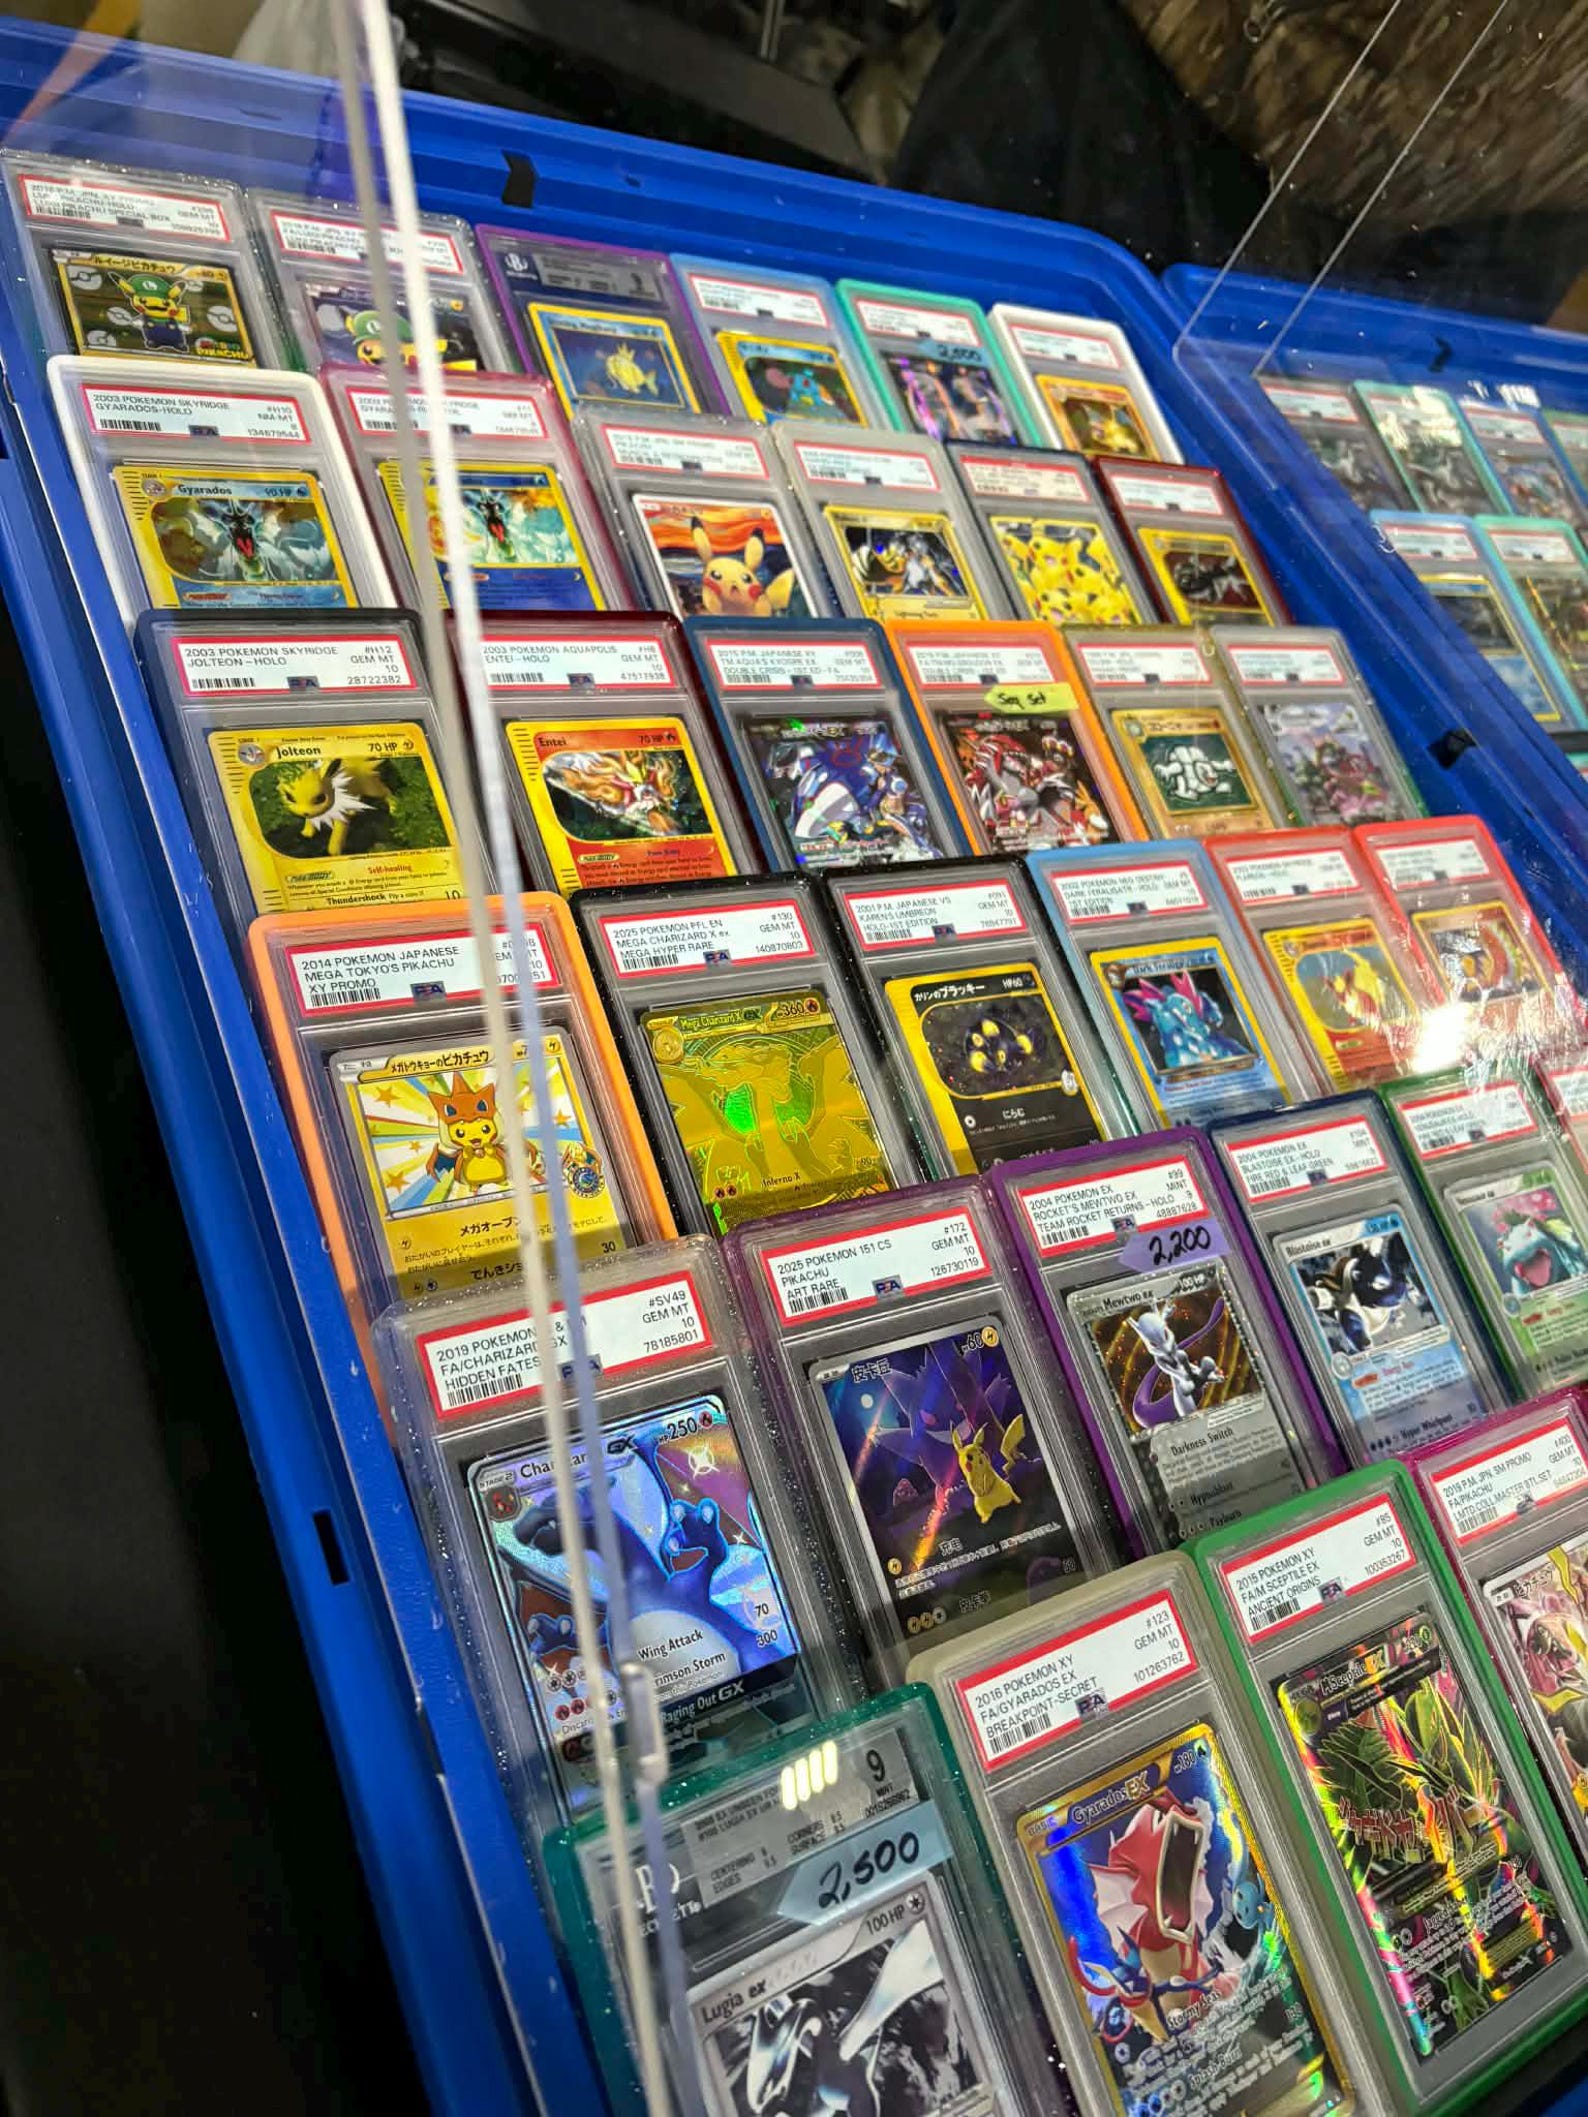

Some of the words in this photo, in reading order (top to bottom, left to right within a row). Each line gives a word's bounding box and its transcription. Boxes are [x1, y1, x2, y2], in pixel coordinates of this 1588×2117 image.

[93, 394, 119, 402] 2003
[122, 396, 175, 405] POKEMON
[178, 399, 228, 408] SKYRIDGE
[96, 403, 192, 414] GYARADOS-HOLO
[178, 483, 232, 496] Gyarados
[185, 648, 216, 656] 2003
[218, 647, 278, 656] POKEMON
[281, 646, 336, 654] SKYRIDGE
[350, 655, 375, 663] GEM
[190, 658, 243, 667] JOLTEON
[253, 657, 287, 665] HOLO
[385, 664, 399, 672] 10
[368, 742, 382, 751] 70
[385, 742, 398, 751] HP
[538, 737, 567, 747] Entei
[638, 735, 651, 744] 70
[653, 735, 663, 743] HP
[276, 746, 321, 759] Jolteon
[326, 893, 386, 905] Thundershock
[613, 928, 638, 938] 2025
[640, 923, 689, 935] POKEMON
[709, 920, 723, 928] EN
[759, 923, 780, 933] GEM
[781, 921, 795, 930] MT
[790, 931, 800, 939] 10
[616, 938, 647, 948] MEGA
[649, 931, 707, 944] CHARIZARD
[302, 959, 332, 970] 2014
[334, 952, 396, 967] POKEMON
[400, 946, 459, 960] JAPANESE
[620, 948, 651, 958] MEGA
[653, 944, 686, 955] HYPER
[688, 941, 714, 951] RARE
[304, 970, 344, 982] MEGA
[346, 963, 400, 977] TOKYO'S
[401, 958, 454, 971] PIKACHU
[309, 983, 326, 994] XY
[330, 978, 376, 991] PROMO
[783, 1001, 804, 1017] 360
[1258, 1145, 1296, 1158] POKEMON
[1166, 1179, 1187, 1191] MINT
[1029, 1197, 1053, 1210] 2004
[1054, 1188, 1100, 1204] POKEMON
[1100, 1185, 1113, 1194] EX
[1033, 1203, 1080, 1221] ROCKET'S
[1080, 1194, 1124, 1211] MEWTWO
[1124, 1191, 1136, 1201] EX
[1037, 1219, 1065, 1232] TEAM
[1066, 1210, 1101, 1226] ROCKET
[1103, 1201, 1144, 1218] RETURNS
[1150, 1194, 1175, 1207] HOLO
[944, 1222, 966, 1234] #172
[601, 1241, 616, 1253] 30
[931, 1237, 953, 1250] GEM
[954, 1233, 969, 1244] MT
[963, 1246, 975, 1256] 10
[1149, 1225, 1211, 1266] 2,200
[777, 1260, 804, 1274] 2025
[805, 1248, 857, 1267] POKEMON
[859, 1243, 876, 1254] 151
[877, 1239, 892, 1250] CS
[930, 1256, 979, 1276] 126730119
[781, 1267, 829, 1287] PIKACHU
[649, 1290, 686, 1307] #SV49
[787, 1286, 808, 1300] ART
[810, 1278, 840, 1294] RARE
[1103, 1293, 1140, 1307] Mewtwo
[642, 1308, 669, 1324] GEM
[670, 1303, 688, 1316] MT
[682, 1316, 695, 1328] 10
[436, 1344, 469, 1361] 2019
[472, 1328, 537, 1352] POKEMON
[643, 1329, 698, 1353] 78185801
[968, 1332, 982, 1350] 60
[445, 1368, 496, 1390] HIDDEN
[498, 1356, 542, 1376] FATES
[667, 1417, 698, 1439] 250
[1170, 1437, 1207, 1456] Darkness
[1207, 1427, 1234, 1443] Switch
[1364, 1531, 1382, 1546] GEM
[1382, 1524, 1395, 1537] MT
[1392, 1538, 1402, 1548] 10
[1236, 1572, 1259, 1590] 2015
[1258, 1554, 1302, 1580] POKEMON
[1301, 1547, 1314, 1560] XY
[1241, 1584, 1266, 1604] FA/M
[1266, 1566, 1307, 1592] SCEPTILE
[1306, 1561, 1320, 1573] EX
[1248, 1591, 1284, 1617] ANCIENT
[1286, 1575, 1321, 1598] ORIGINS
[755, 1604, 769, 1617] 70
[1146, 1610, 1169, 1629] #123
[638, 1643, 667, 1661] Wing
[668, 1629, 703, 1651] Attack
[757, 1629, 778, 1647] 300
[1134, 1631, 1157, 1650] GEM
[1157, 1623, 1172, 1639] MT
[1168, 1638, 1180, 1650] 10
[693, 1652, 727, 1671] Storm
[1134, 1651, 1184, 1683] 101263762
[975, 1687, 1003, 1708] 2016
[1003, 1662, 1058, 1695] POKEMON
[1058, 1654, 1073, 1669] XY
[697, 1695, 717, 1710] Out
[718, 1680, 745, 1700] GX
[980, 1677, 1061, 1723] FA/GYARADOS
[1061, 1670, 1077, 1685] EX
[986, 1676, 1097, 1738] BREAKPOINT-SECRET
[866, 1749, 885, 1781] 9
[1071, 1786, 1127, 1826] Gyarados
[1125, 1769, 1150, 1800] EX
[818, 1832, 920, 1910] 2,500
[866, 1914, 889, 1936] 100
[888, 1905, 906, 1925] HP
[701, 1992, 744, 2023] Lugia
[748, 1980, 767, 1999] ex
